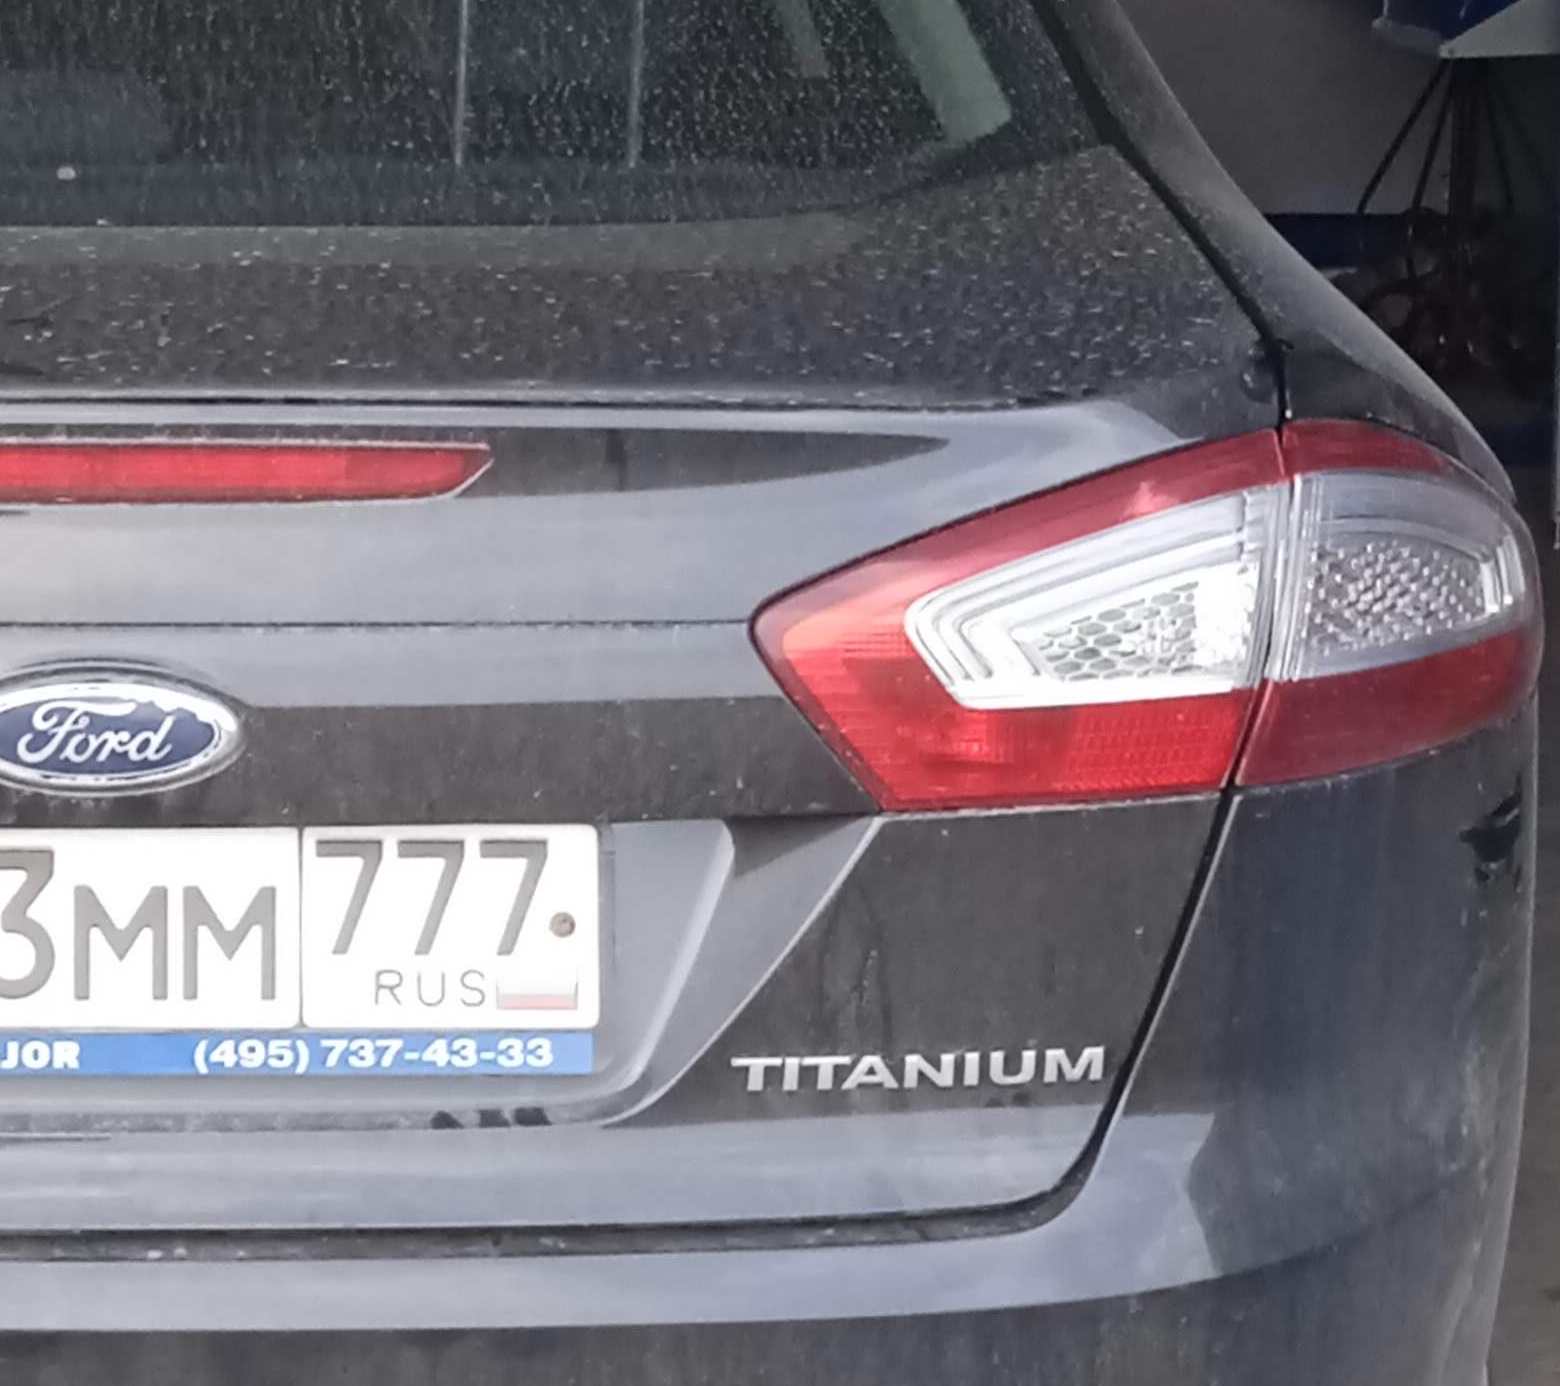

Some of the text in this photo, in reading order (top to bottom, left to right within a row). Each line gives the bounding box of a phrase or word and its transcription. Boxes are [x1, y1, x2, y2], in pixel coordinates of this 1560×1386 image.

[17, 700, 176, 764] Ford
[314, 839, 550, 956] 777
[374, 969, 487, 1007] RUS
[193, 1040, 555, 1075] (495) 737-43-33
[731, 1046, 1105, 1091] TITANIUM
